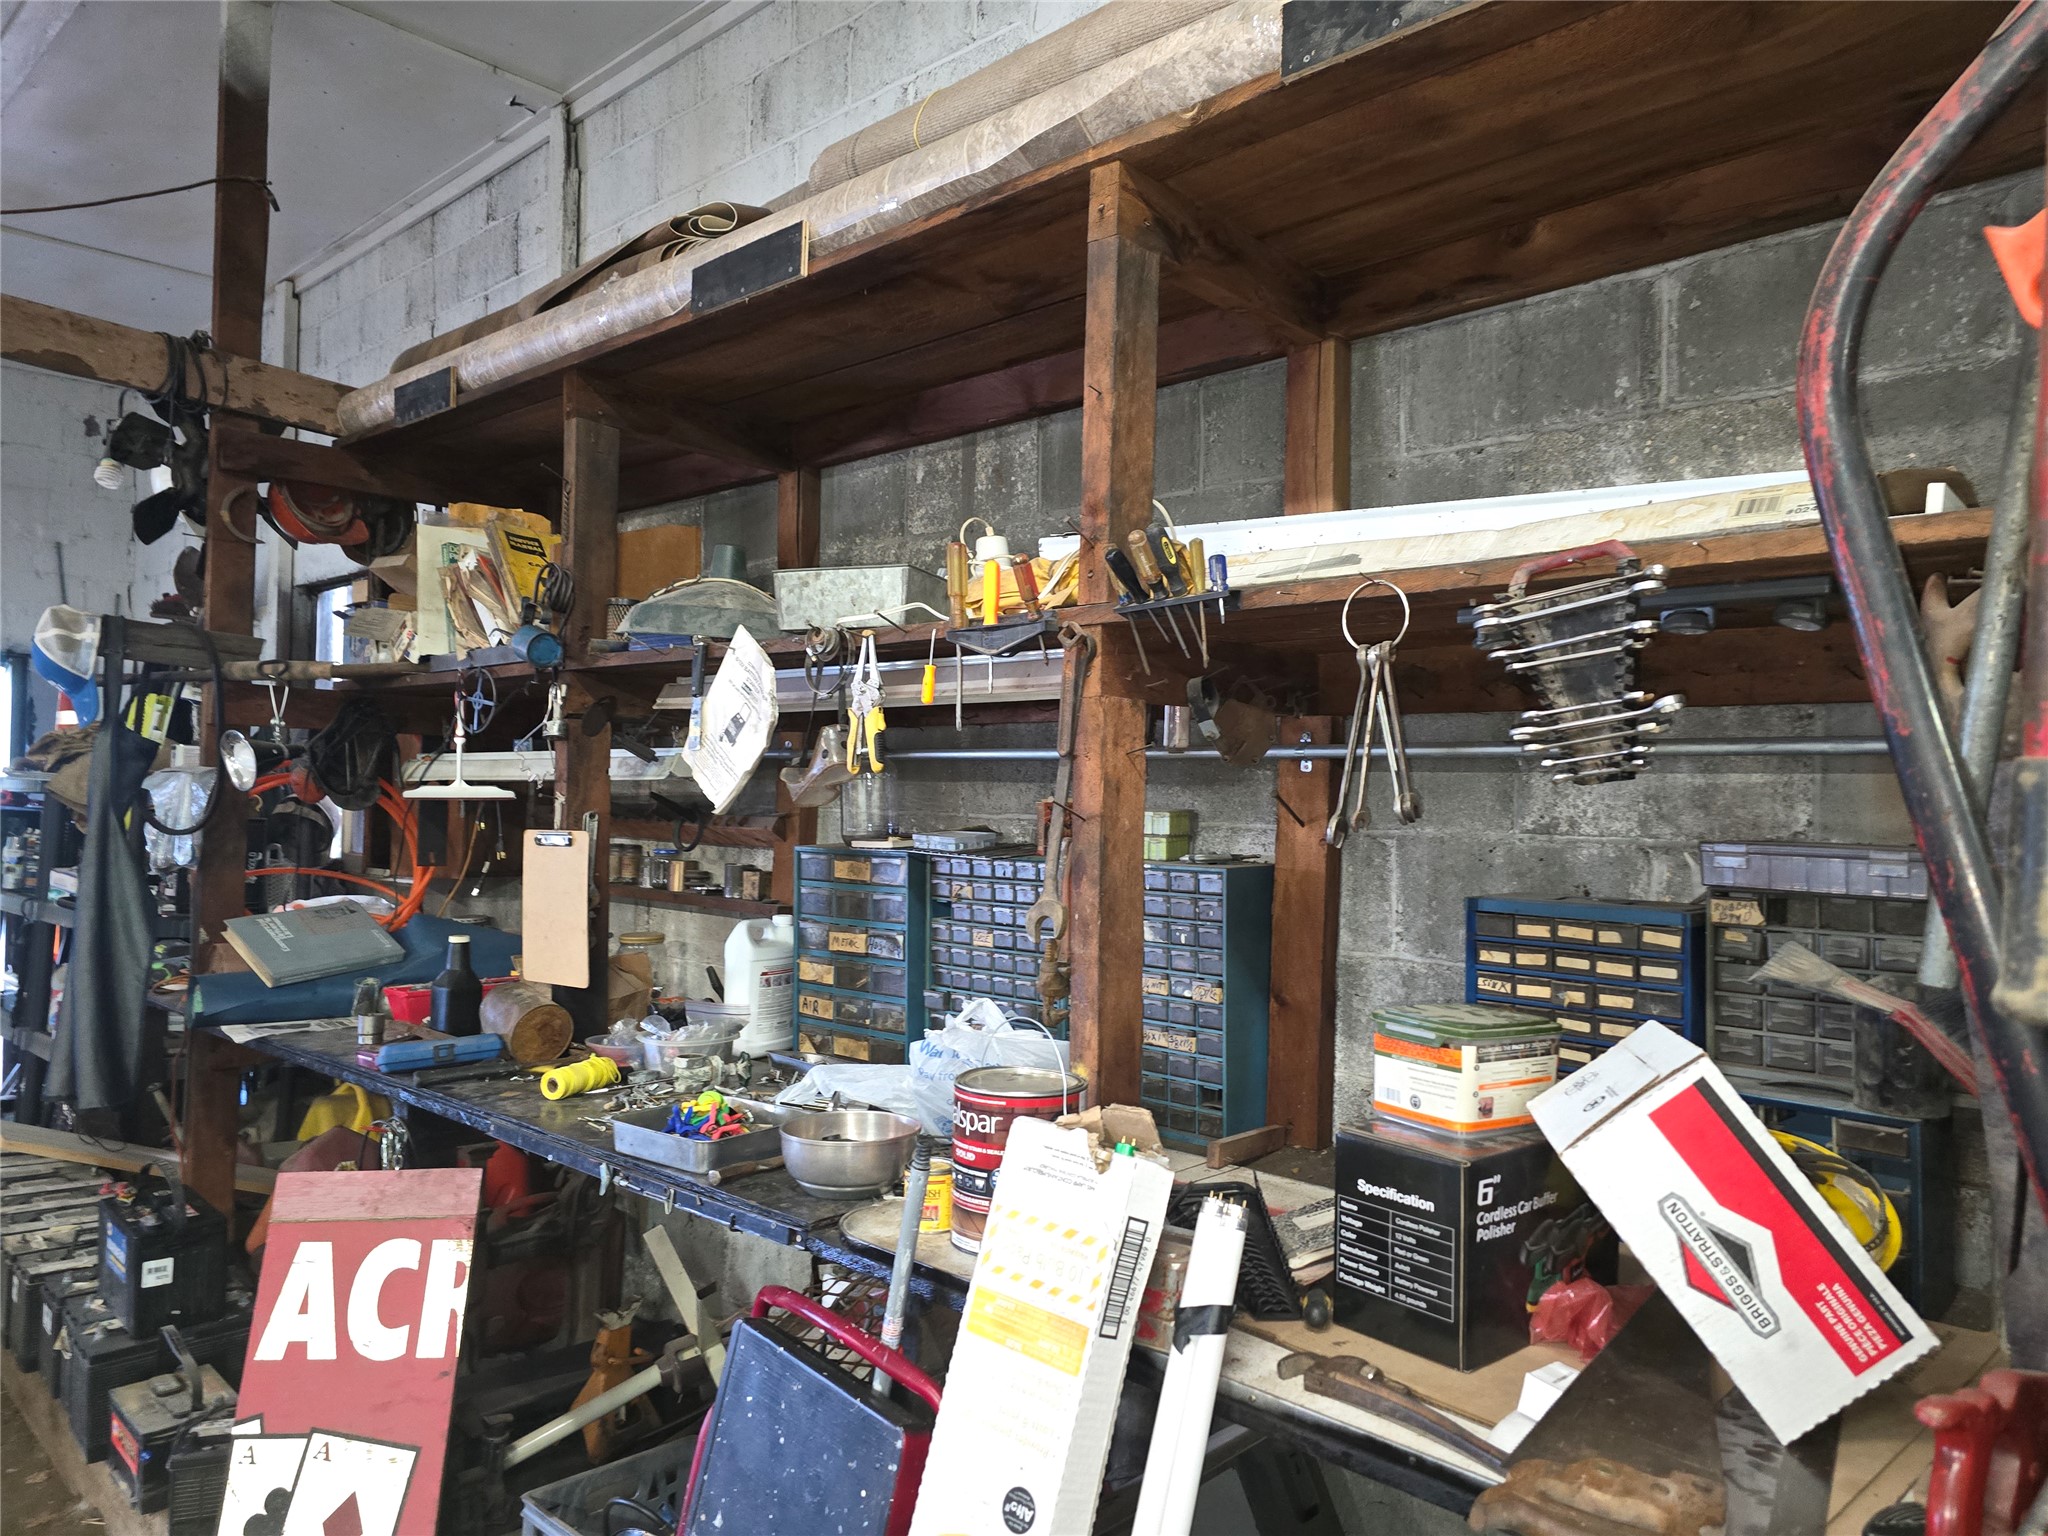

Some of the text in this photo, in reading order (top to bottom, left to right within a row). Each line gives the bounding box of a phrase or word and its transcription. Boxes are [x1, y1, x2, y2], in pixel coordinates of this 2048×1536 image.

[802, 997, 819, 1015] AIR
[953, 1101, 1004, 1136] alspar
[1340, 1200, 1358, 1212] Name
[1357, 1178, 1436, 1213] Specification
[1476, 1191, 1559, 1226] Cordless Car Buffer
[1340, 1214, 1364, 1228] Voltage
[1340, 1229, 1358, 1240] Color
[1402, 1234, 1417, 1245] Volts
[1476, 1221, 1517, 1243] Polisher
[1340, 1242, 1379, 1261] Manufacturer
[1412, 1252, 1431, 1264] Green
[1340, 1256, 1359, 1270] Power
[1358, 1263, 1380, 1277] Source
[1339, 1271, 1386, 1294] Package Weight
[1394, 1276, 1438, 1297] Battery Powered
[252, 1237, 475, 1362] ACR
[1816, 1282, 1858, 1331] ORIGINALE
[1831, 1282, 1867, 1324] GENUINA
[1814, 1301, 1869, 1363] GENUINE PART
[1863, 1322, 1888, 1350] PIEZA
[238, 1445, 257, 1465] A
[313, 1442, 333, 1462] A
